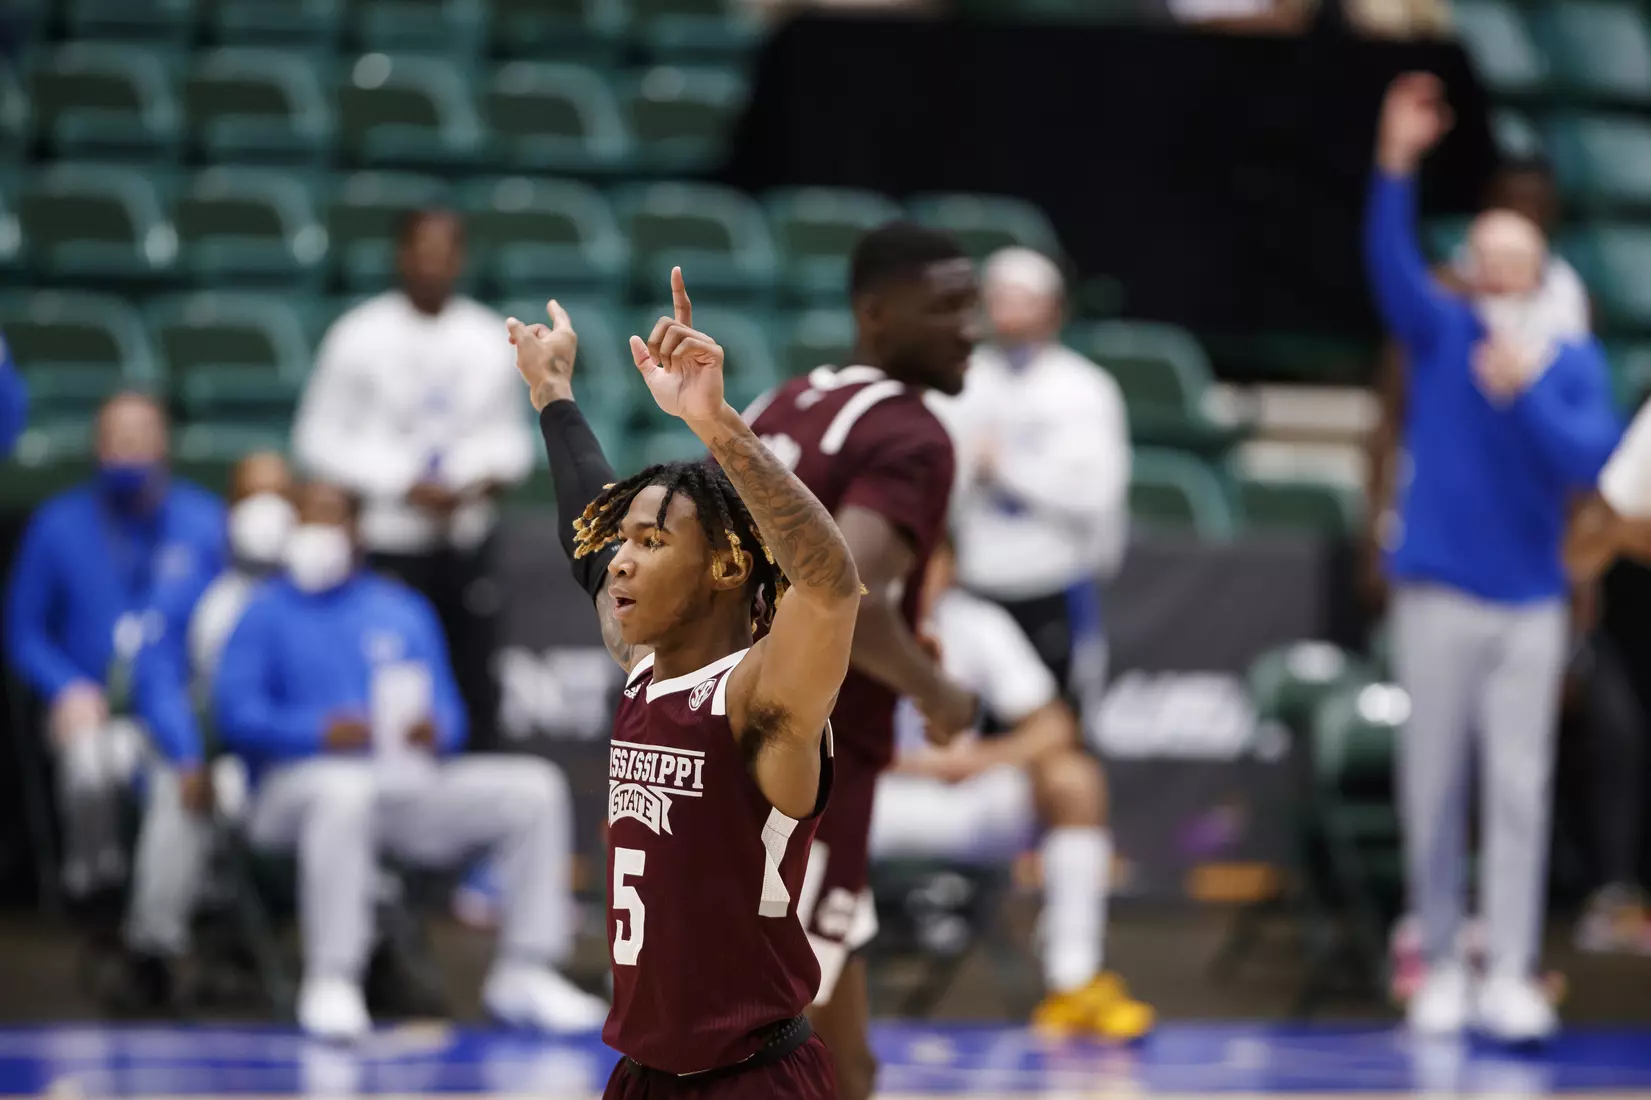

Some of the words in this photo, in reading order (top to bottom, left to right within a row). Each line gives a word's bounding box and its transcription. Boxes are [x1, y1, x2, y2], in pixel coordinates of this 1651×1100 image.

[610, 747, 704, 789] ISSISSIPPI
[613, 789, 653, 823] STATE
[613, 847, 646, 966] 5
